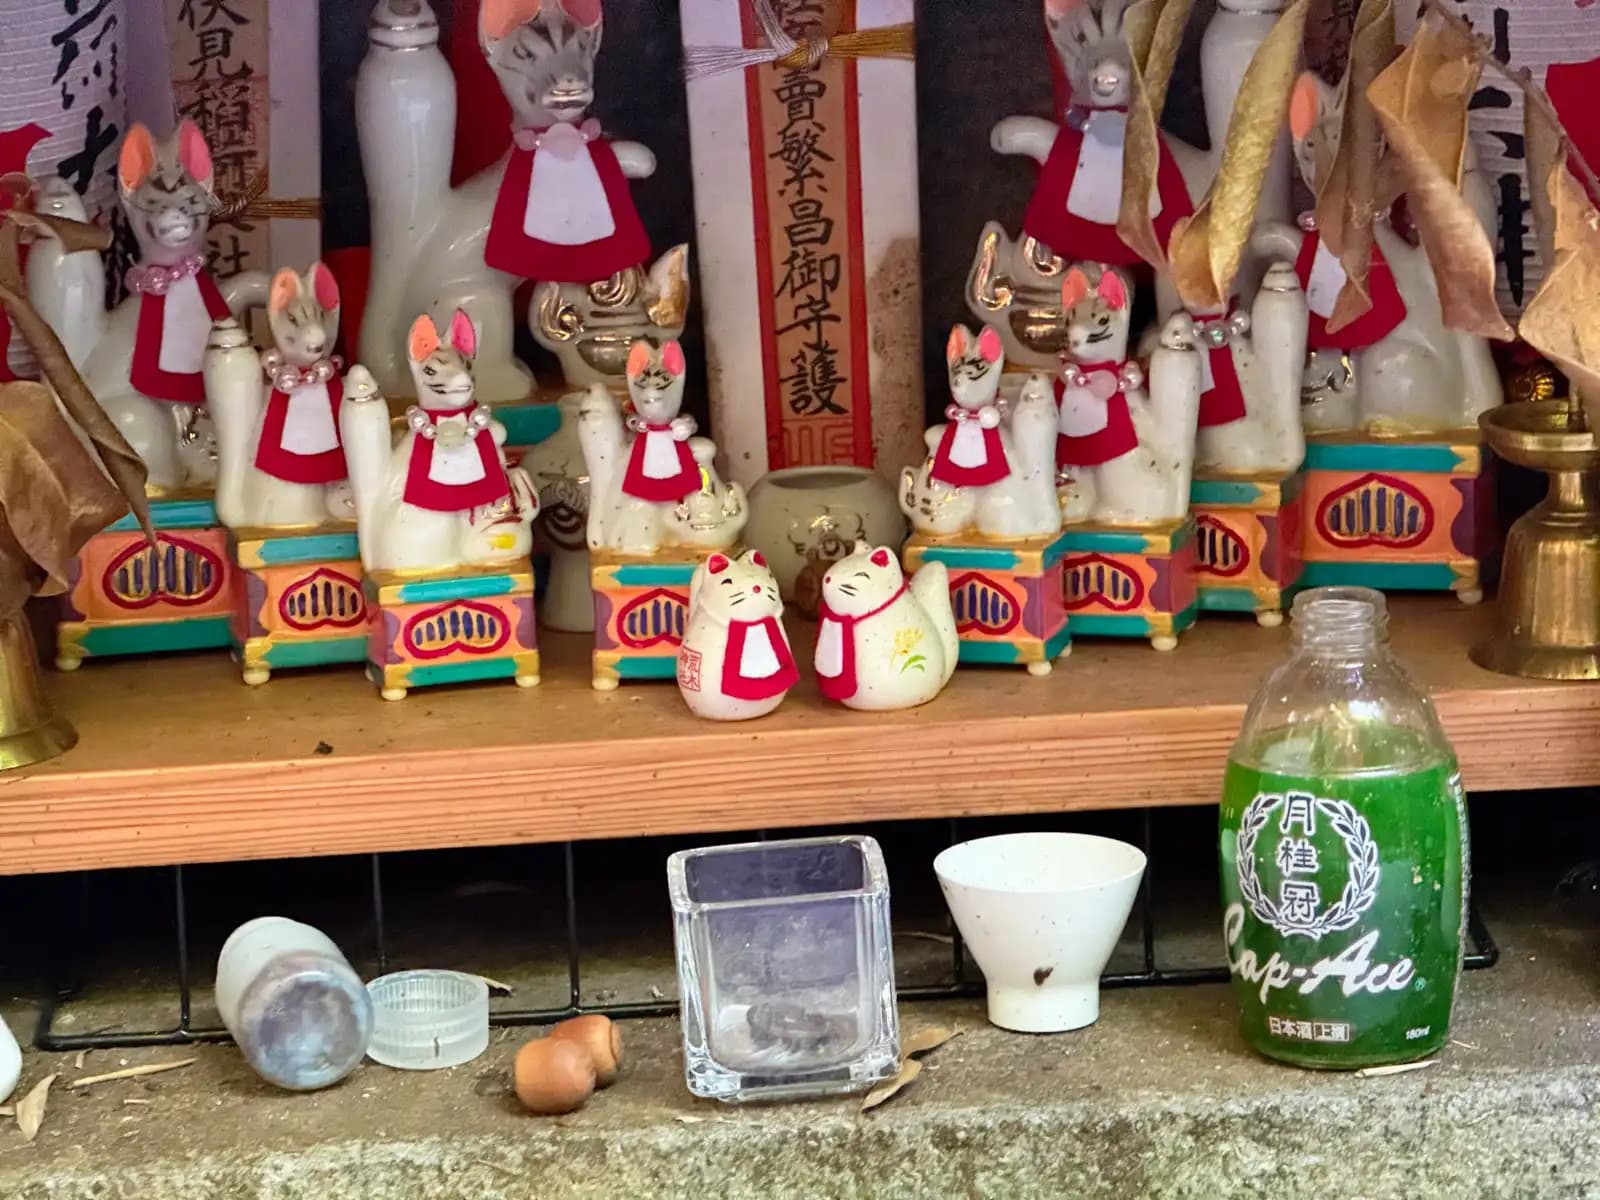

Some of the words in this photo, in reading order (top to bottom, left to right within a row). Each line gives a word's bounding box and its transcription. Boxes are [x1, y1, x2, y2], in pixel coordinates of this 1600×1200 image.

[1278, 791, 1320, 925] 月桂冠
[1223, 903, 1417, 1006] Cap-Ace
